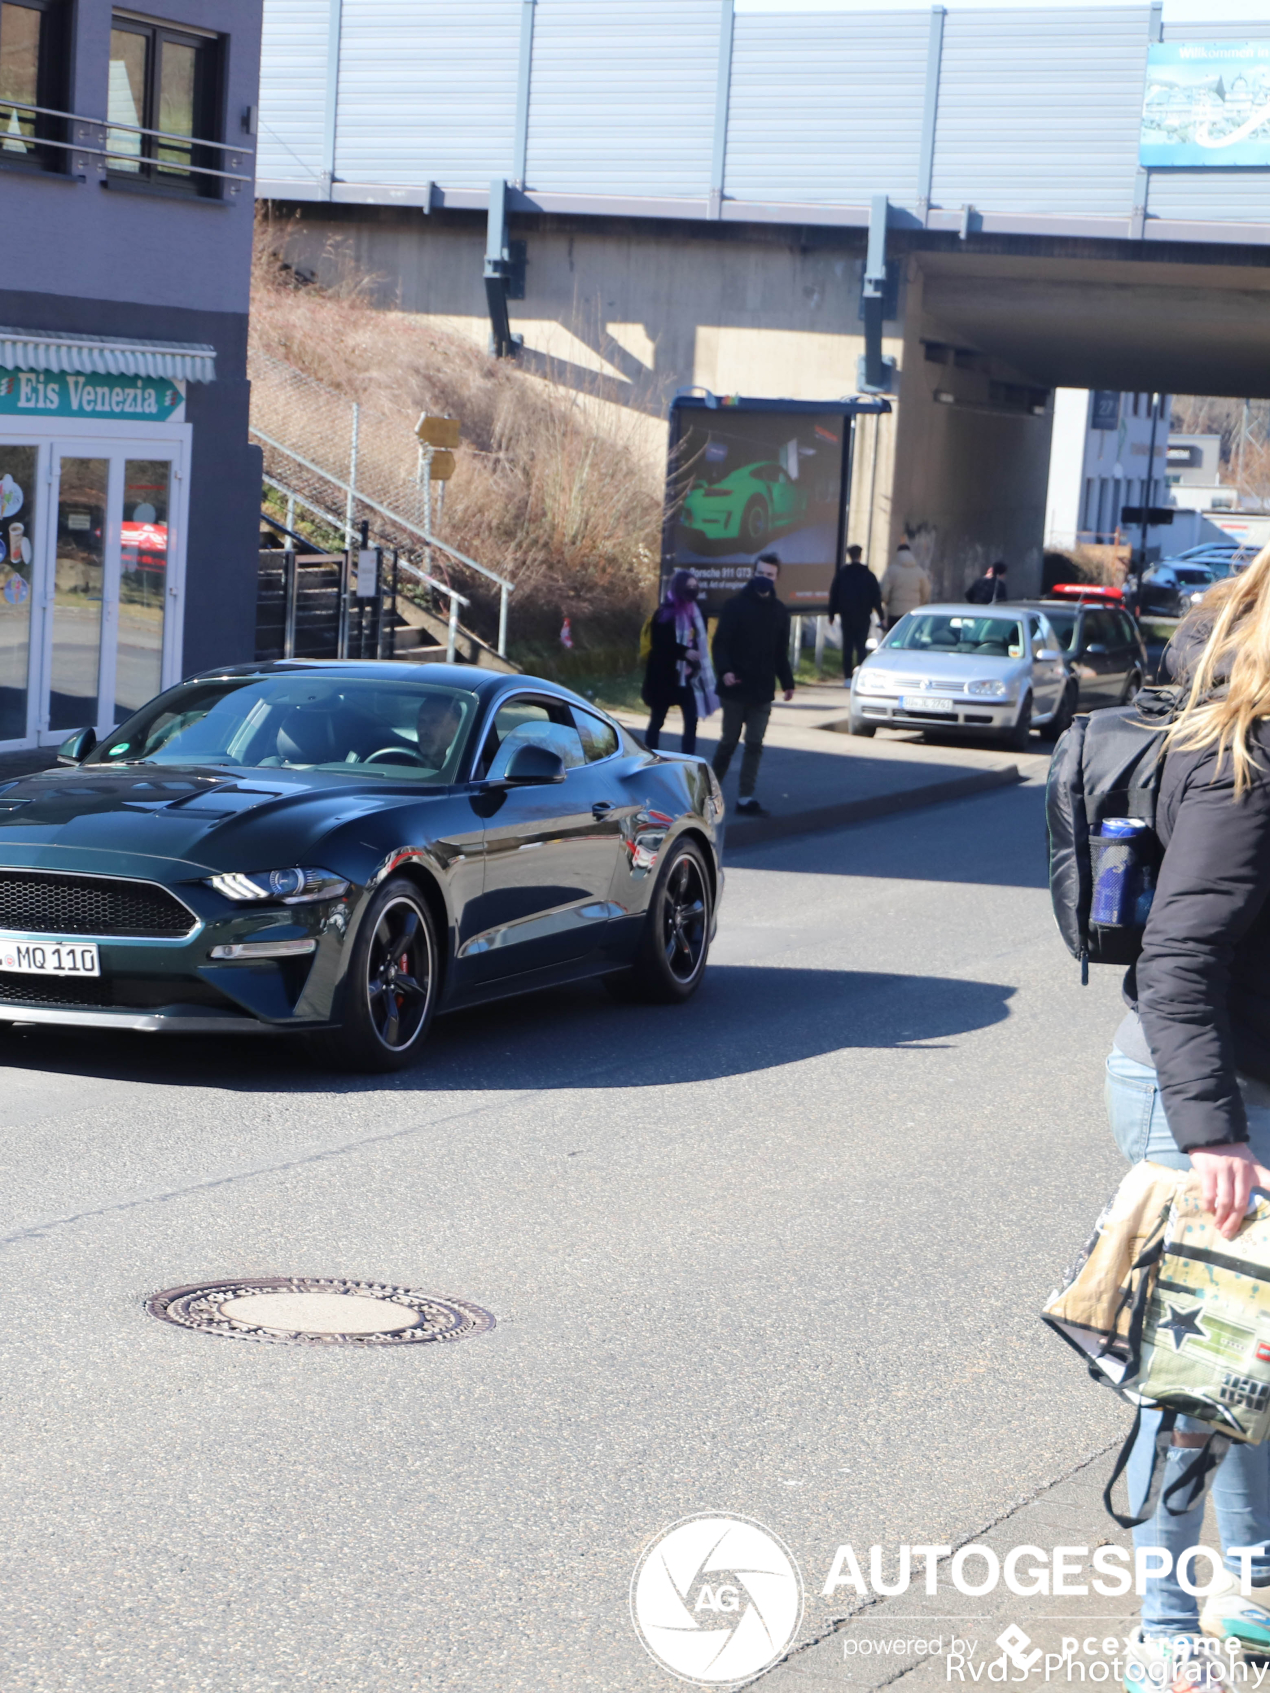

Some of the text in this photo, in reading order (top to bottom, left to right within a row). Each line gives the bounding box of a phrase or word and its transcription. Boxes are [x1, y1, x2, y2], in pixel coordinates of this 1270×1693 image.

[1179, 46, 1270, 59] Willkommen in
[17, 372, 158, 413] Eis Venezia
[722, 567, 734, 578] 911
[736, 567, 752, 579] GT3
[16, 946, 48, 970] MQ
[52, 948, 95, 972] 110
